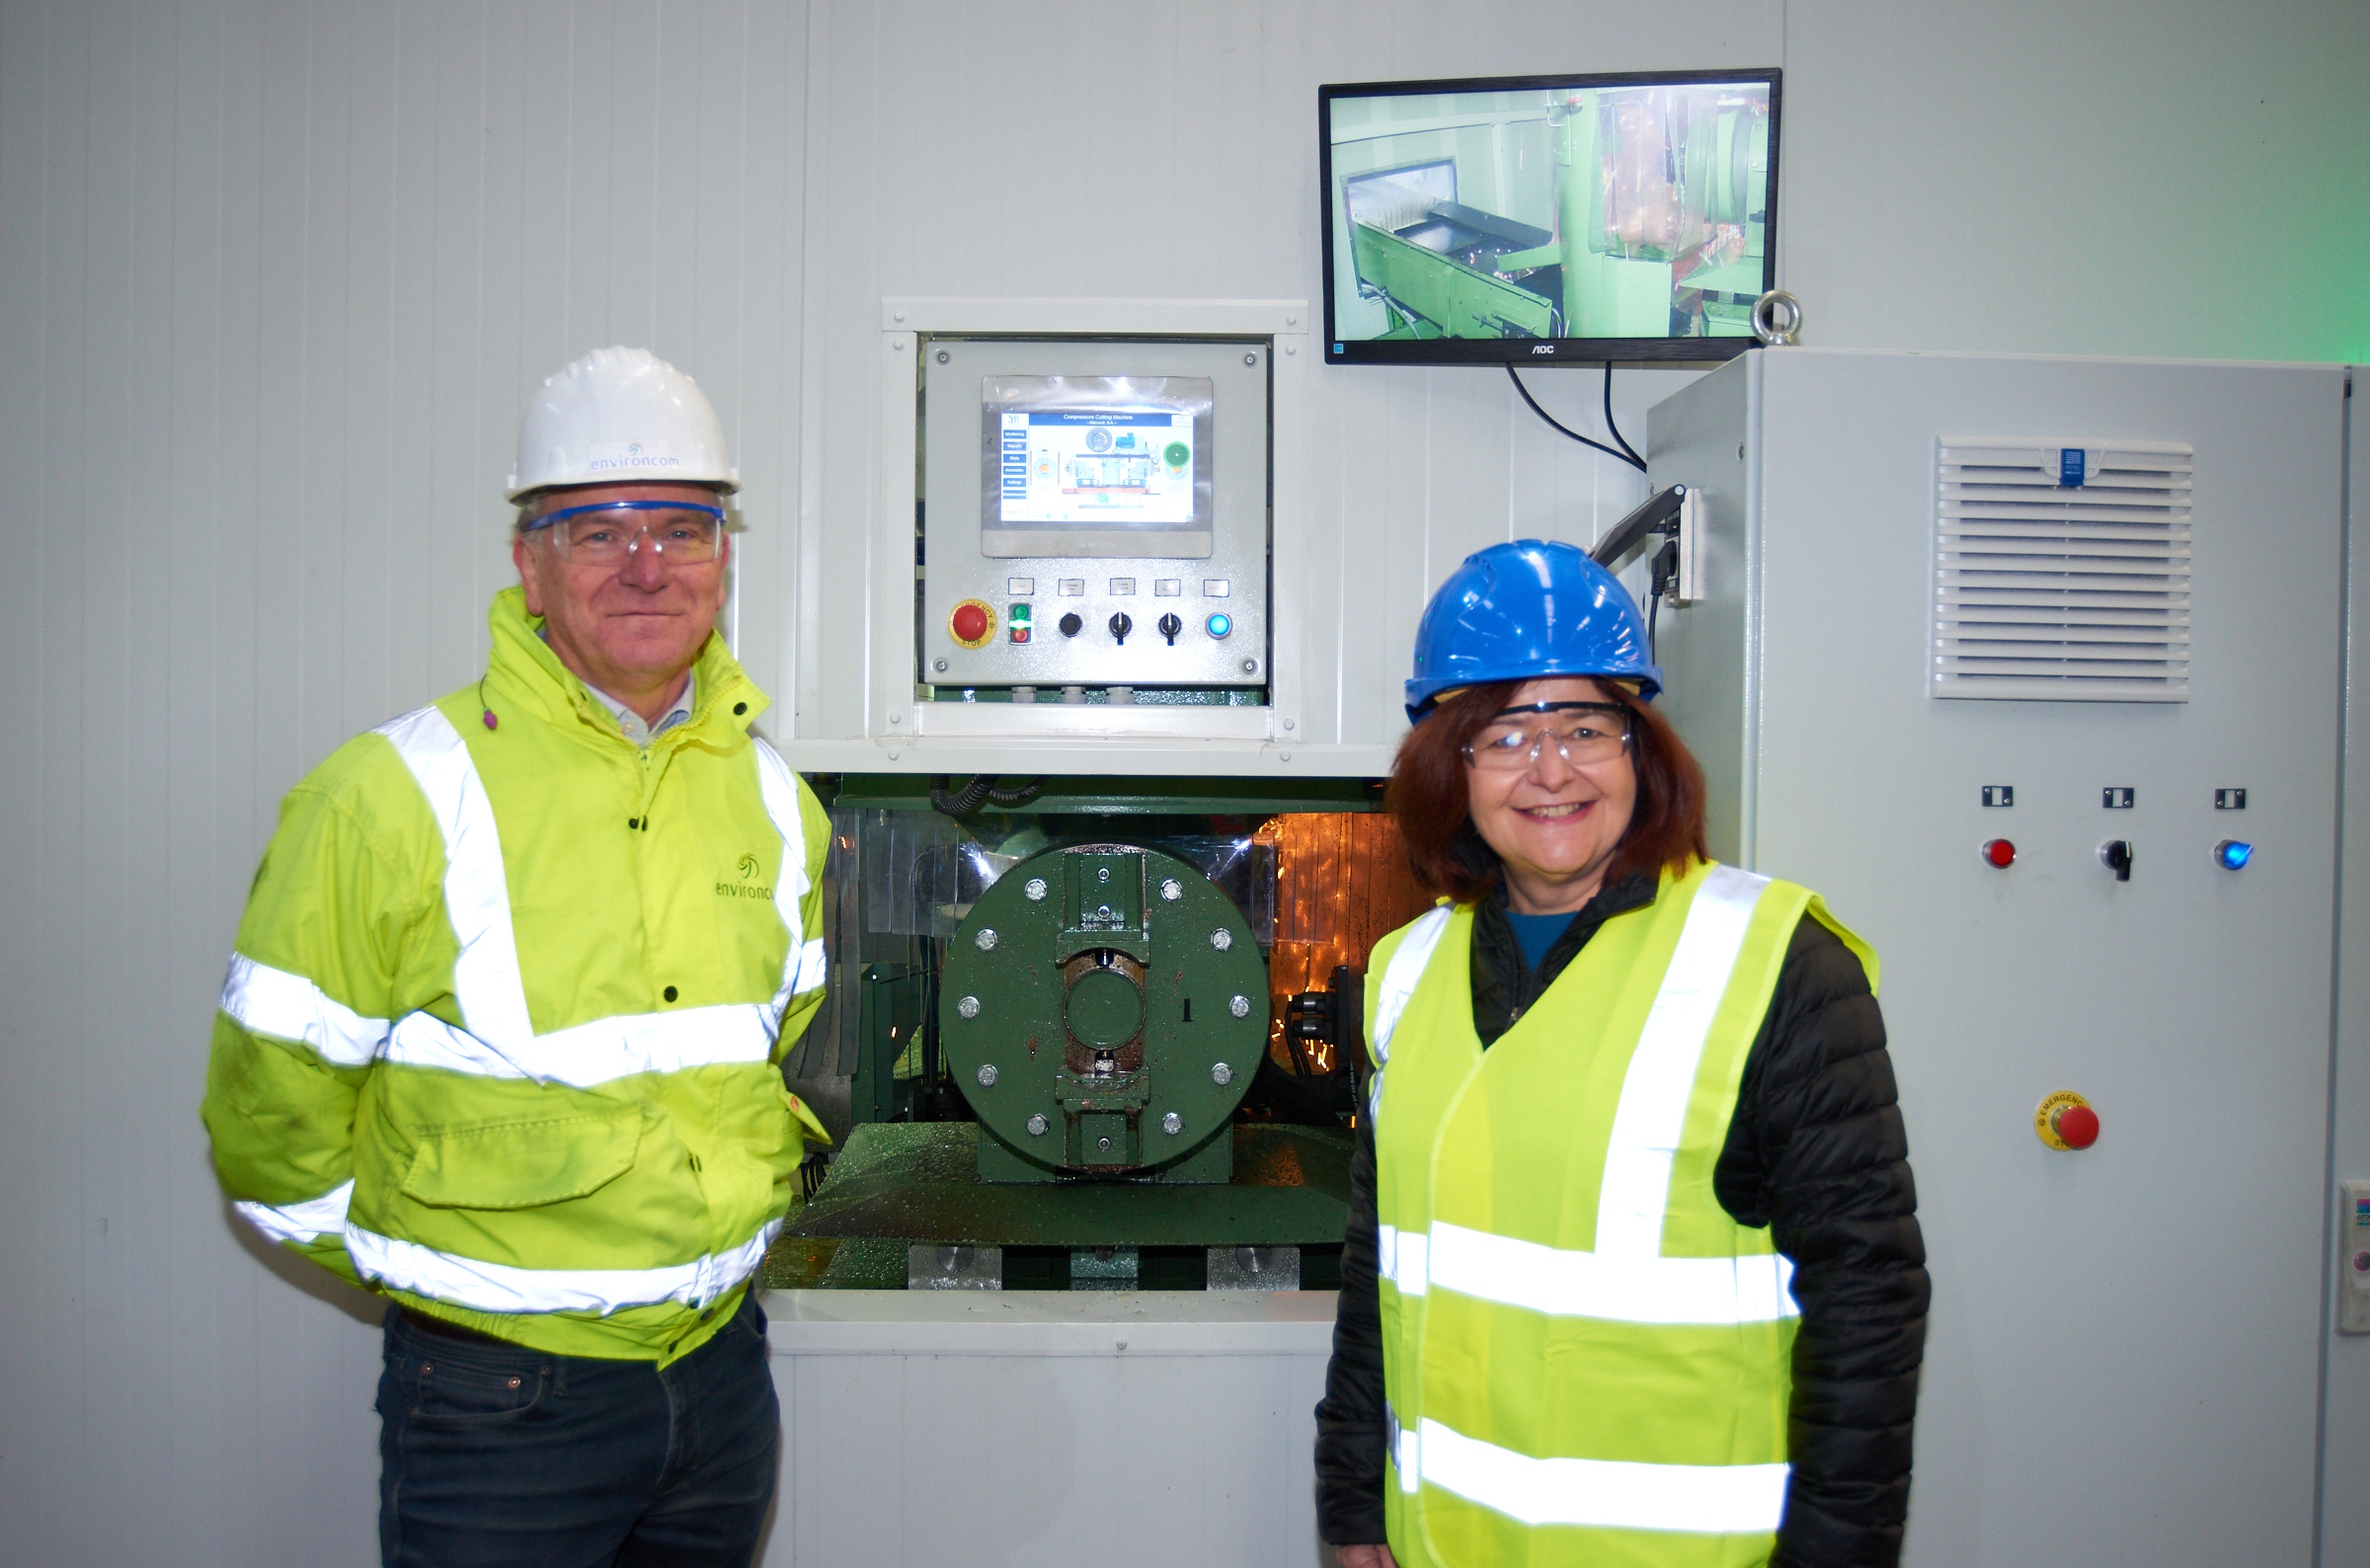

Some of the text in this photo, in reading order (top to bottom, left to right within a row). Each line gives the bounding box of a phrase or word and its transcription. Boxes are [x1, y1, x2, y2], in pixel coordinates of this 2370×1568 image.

[1532, 346, 1554, 354] AOC
[591, 454, 679, 470] environcom
[716, 881, 774, 901] environc
[2040, 1095, 2084, 1116] EMERGENC
